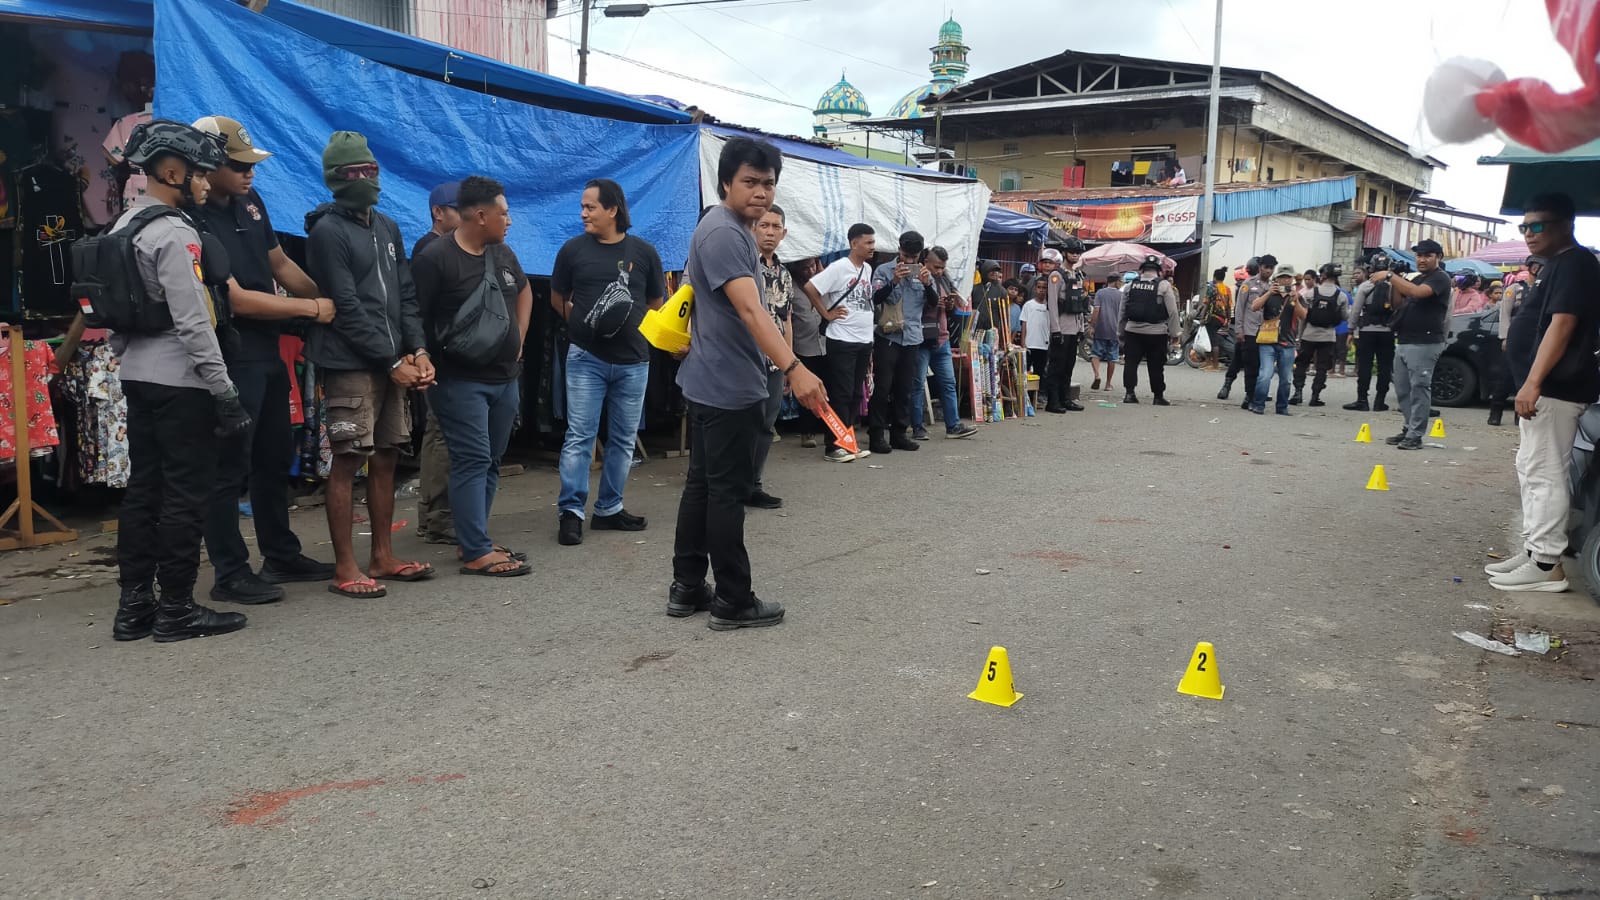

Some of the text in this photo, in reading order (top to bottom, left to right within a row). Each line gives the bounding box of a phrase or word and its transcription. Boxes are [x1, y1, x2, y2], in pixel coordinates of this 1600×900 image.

[1049, 217, 1086, 234] Surya
[1167, 212, 1196, 223] GGSP
[1132, 283, 1155, 291] POLISI
[679, 301, 689, 318] 6
[1197, 652, 1207, 672] 2
[987, 661, 997, 681] 5
